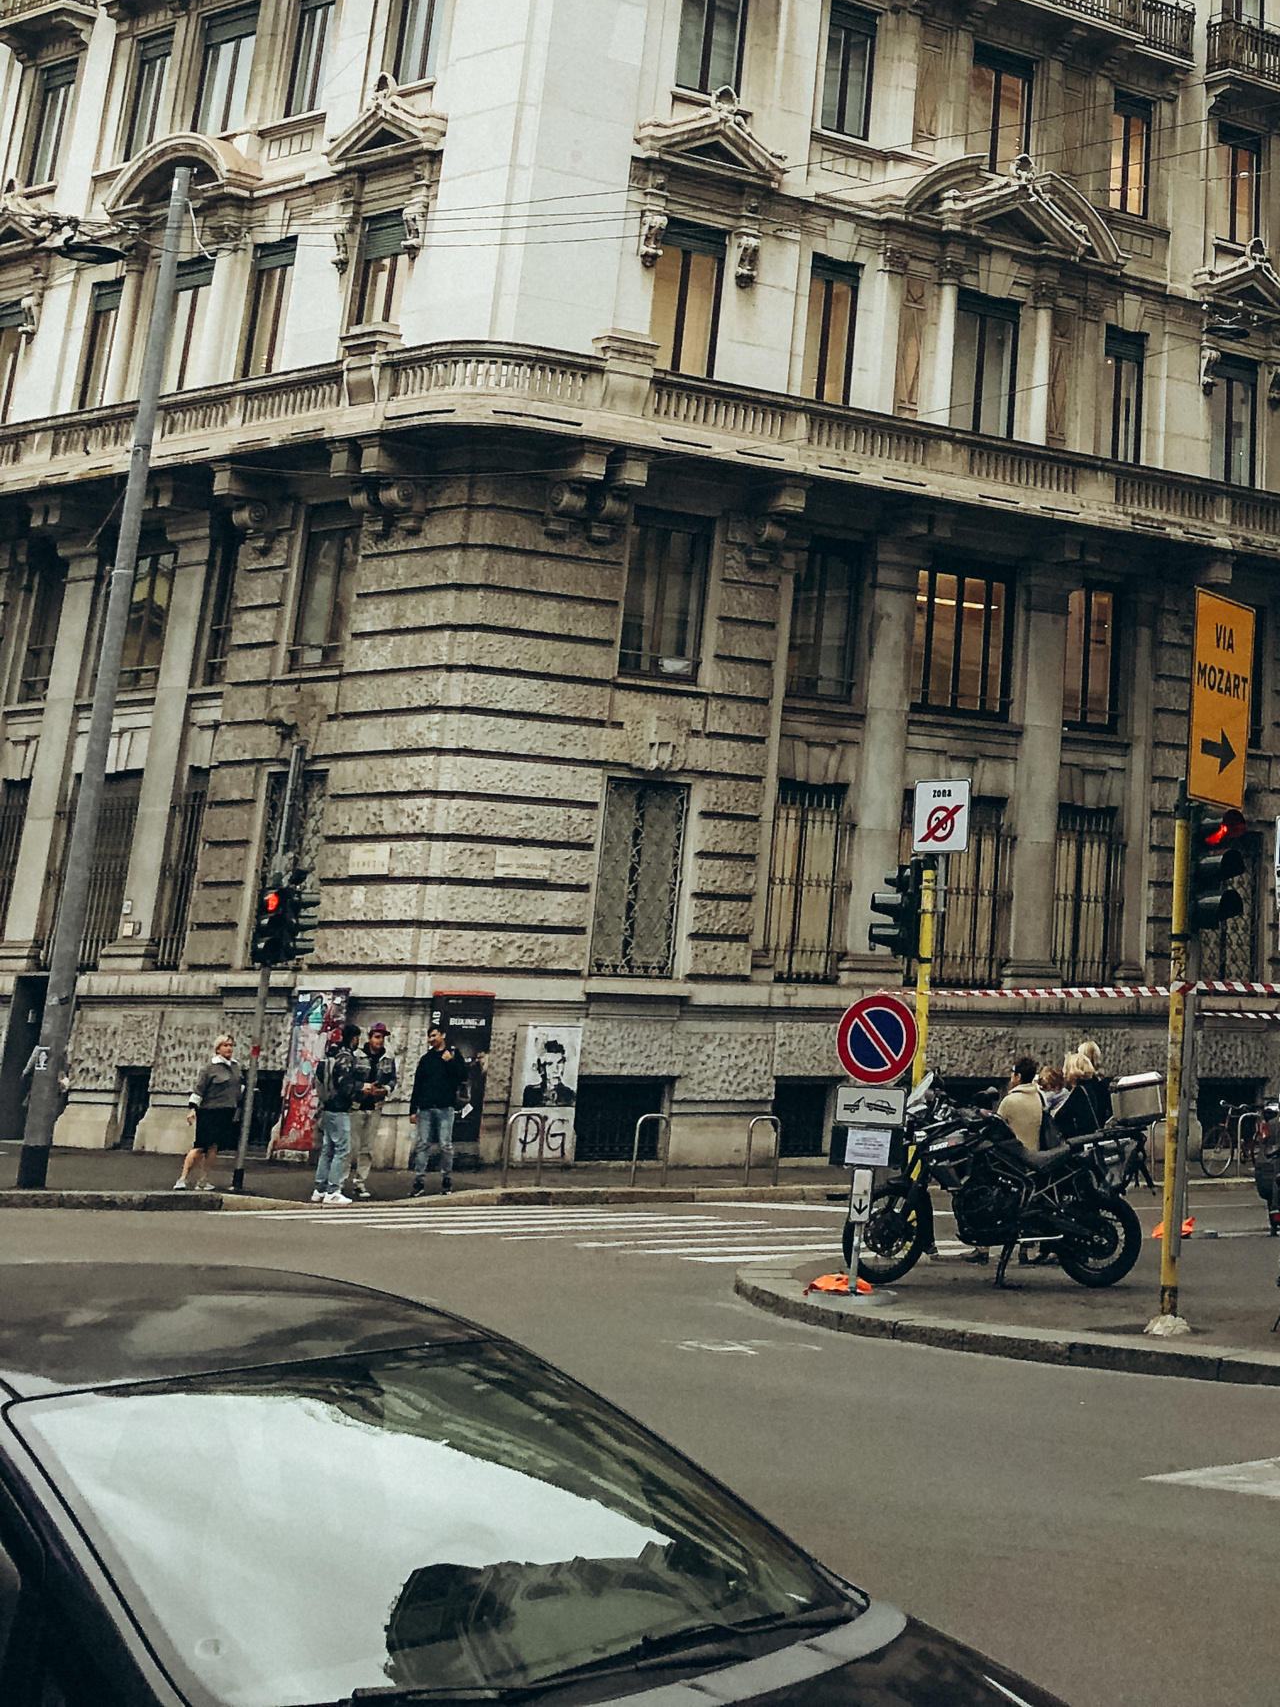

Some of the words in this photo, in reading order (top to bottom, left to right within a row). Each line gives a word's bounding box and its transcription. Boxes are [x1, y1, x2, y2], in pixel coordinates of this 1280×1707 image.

[1215, 623, 1235, 654] VIA
[1197, 661, 1249, 701] MOZART
[932, 789, 952, 798] zona
